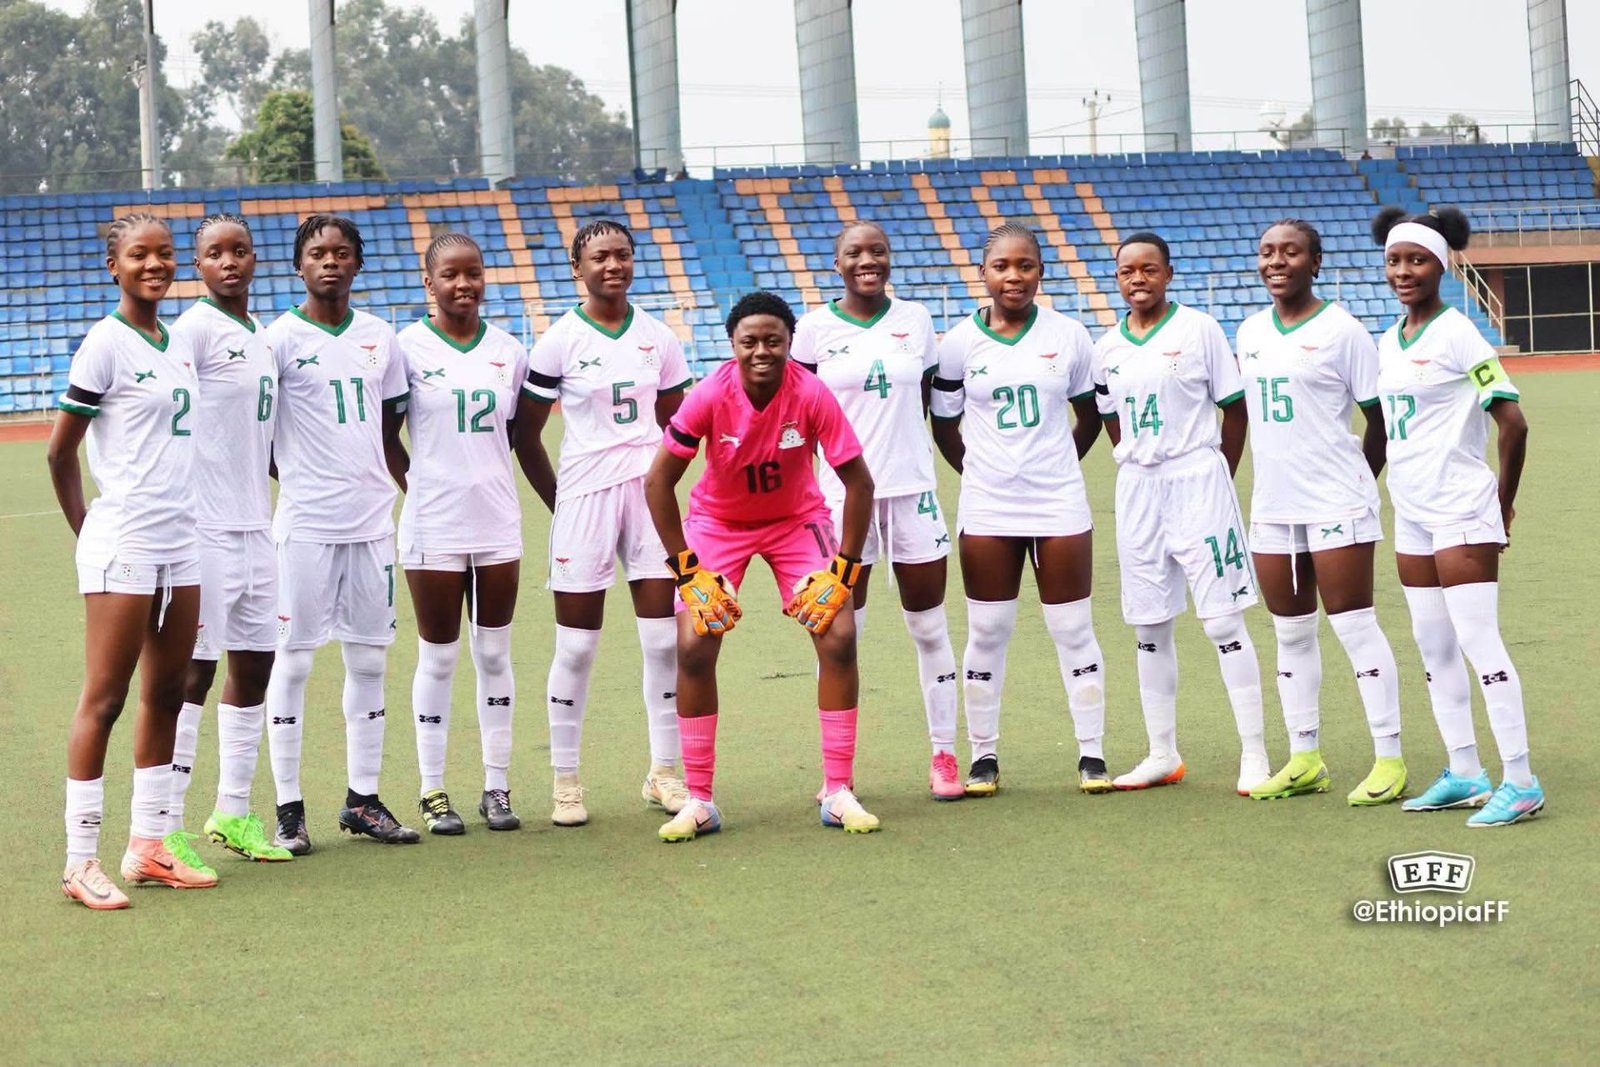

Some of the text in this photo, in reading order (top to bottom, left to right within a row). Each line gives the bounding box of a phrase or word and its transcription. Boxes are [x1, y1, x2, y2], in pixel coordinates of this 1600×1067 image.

[864, 359, 891, 399] 4
[1476, 364, 1495, 387] C
[171, 388, 191, 436] 2
[257, 376, 273, 422] 6
[329, 377, 366, 424] 11
[452, 388, 496, 433] 12
[612, 380, 638, 424] 5
[993, 384, 1040, 429] 20
[1126, 393, 1163, 438] 14
[1257, 377, 1294, 422] 15
[747, 462, 782, 493] 16
[918, 491, 938, 520] 4
[1205, 528, 1246, 577] 14
